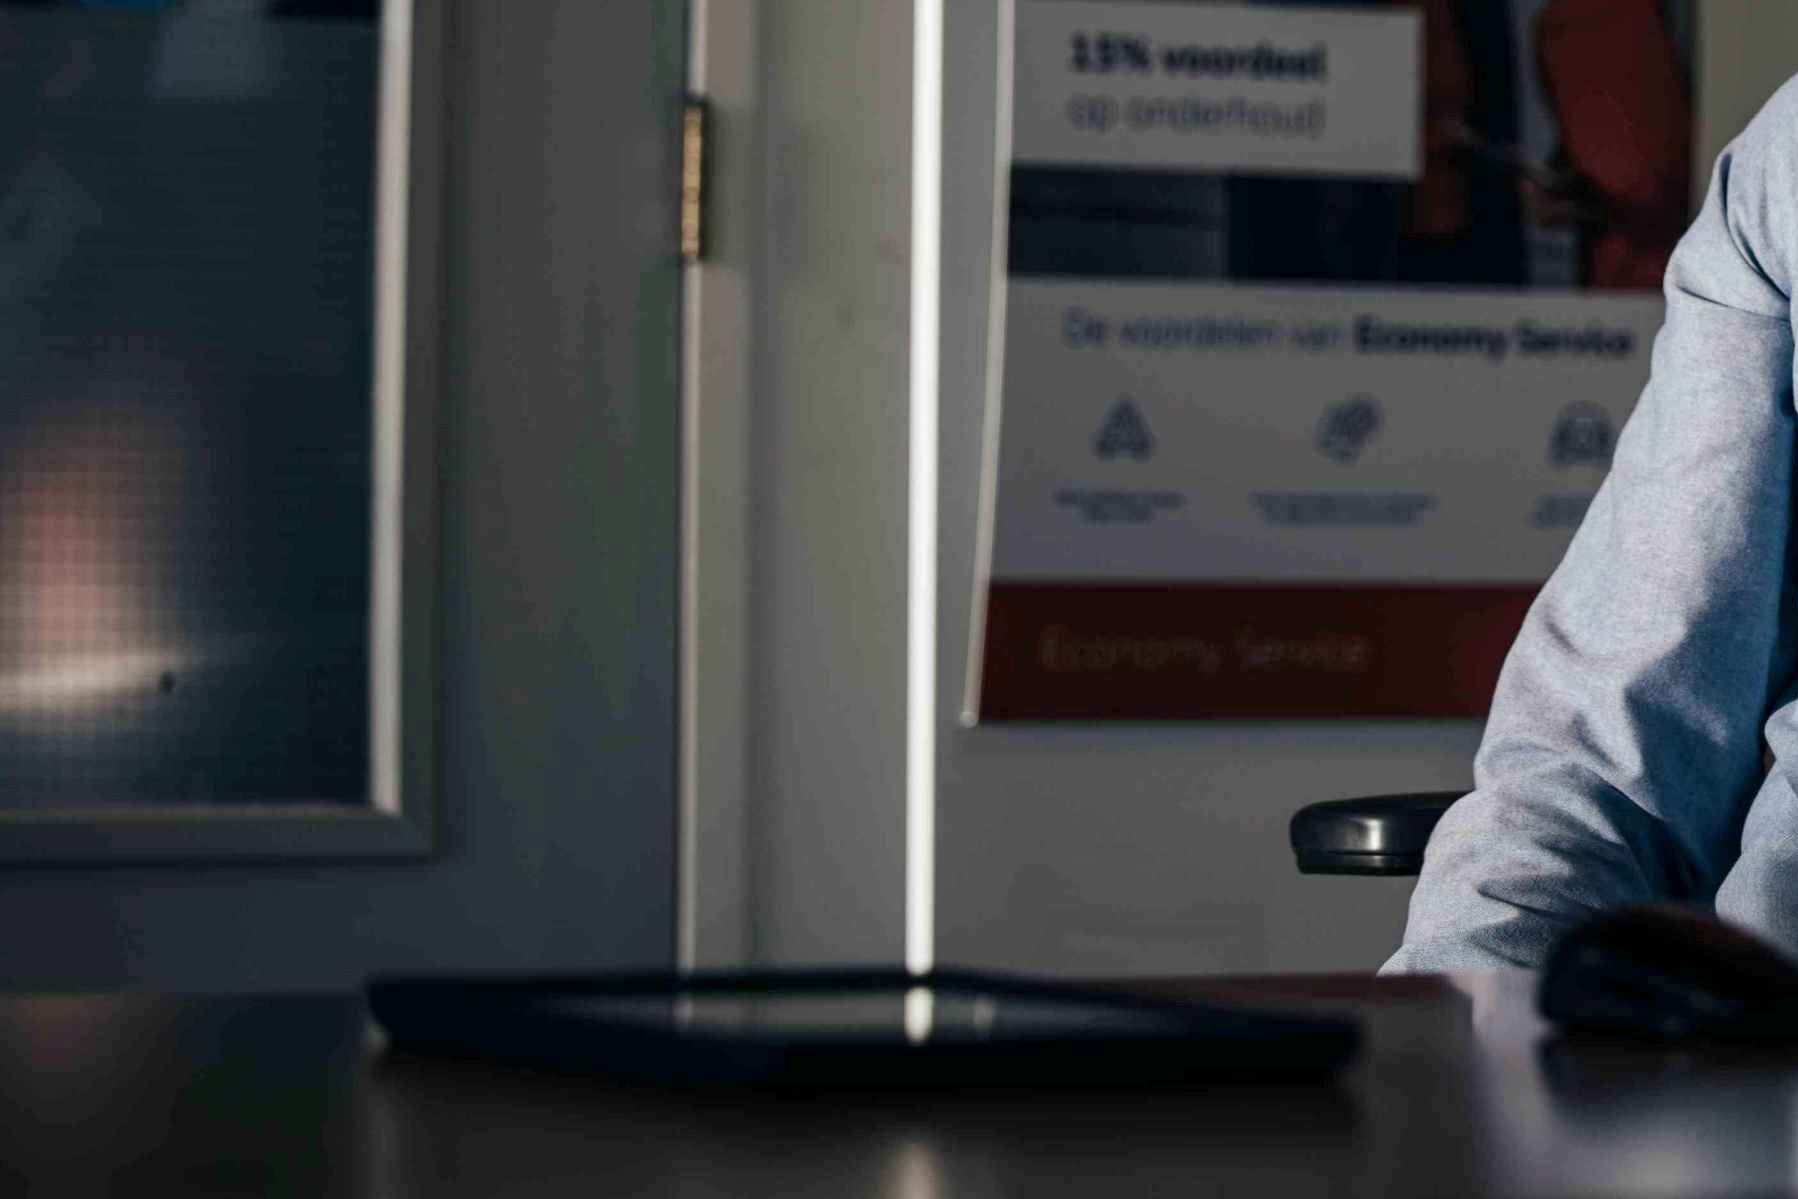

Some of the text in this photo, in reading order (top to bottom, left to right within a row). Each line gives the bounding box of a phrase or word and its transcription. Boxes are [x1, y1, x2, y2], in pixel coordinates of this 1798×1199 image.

[1160, 40, 1328, 82] voordeel
[1352, 314, 1506, 366] Economy
[1516, 322, 1636, 360] Service
[1038, 623, 1372, 678] Economy Service
